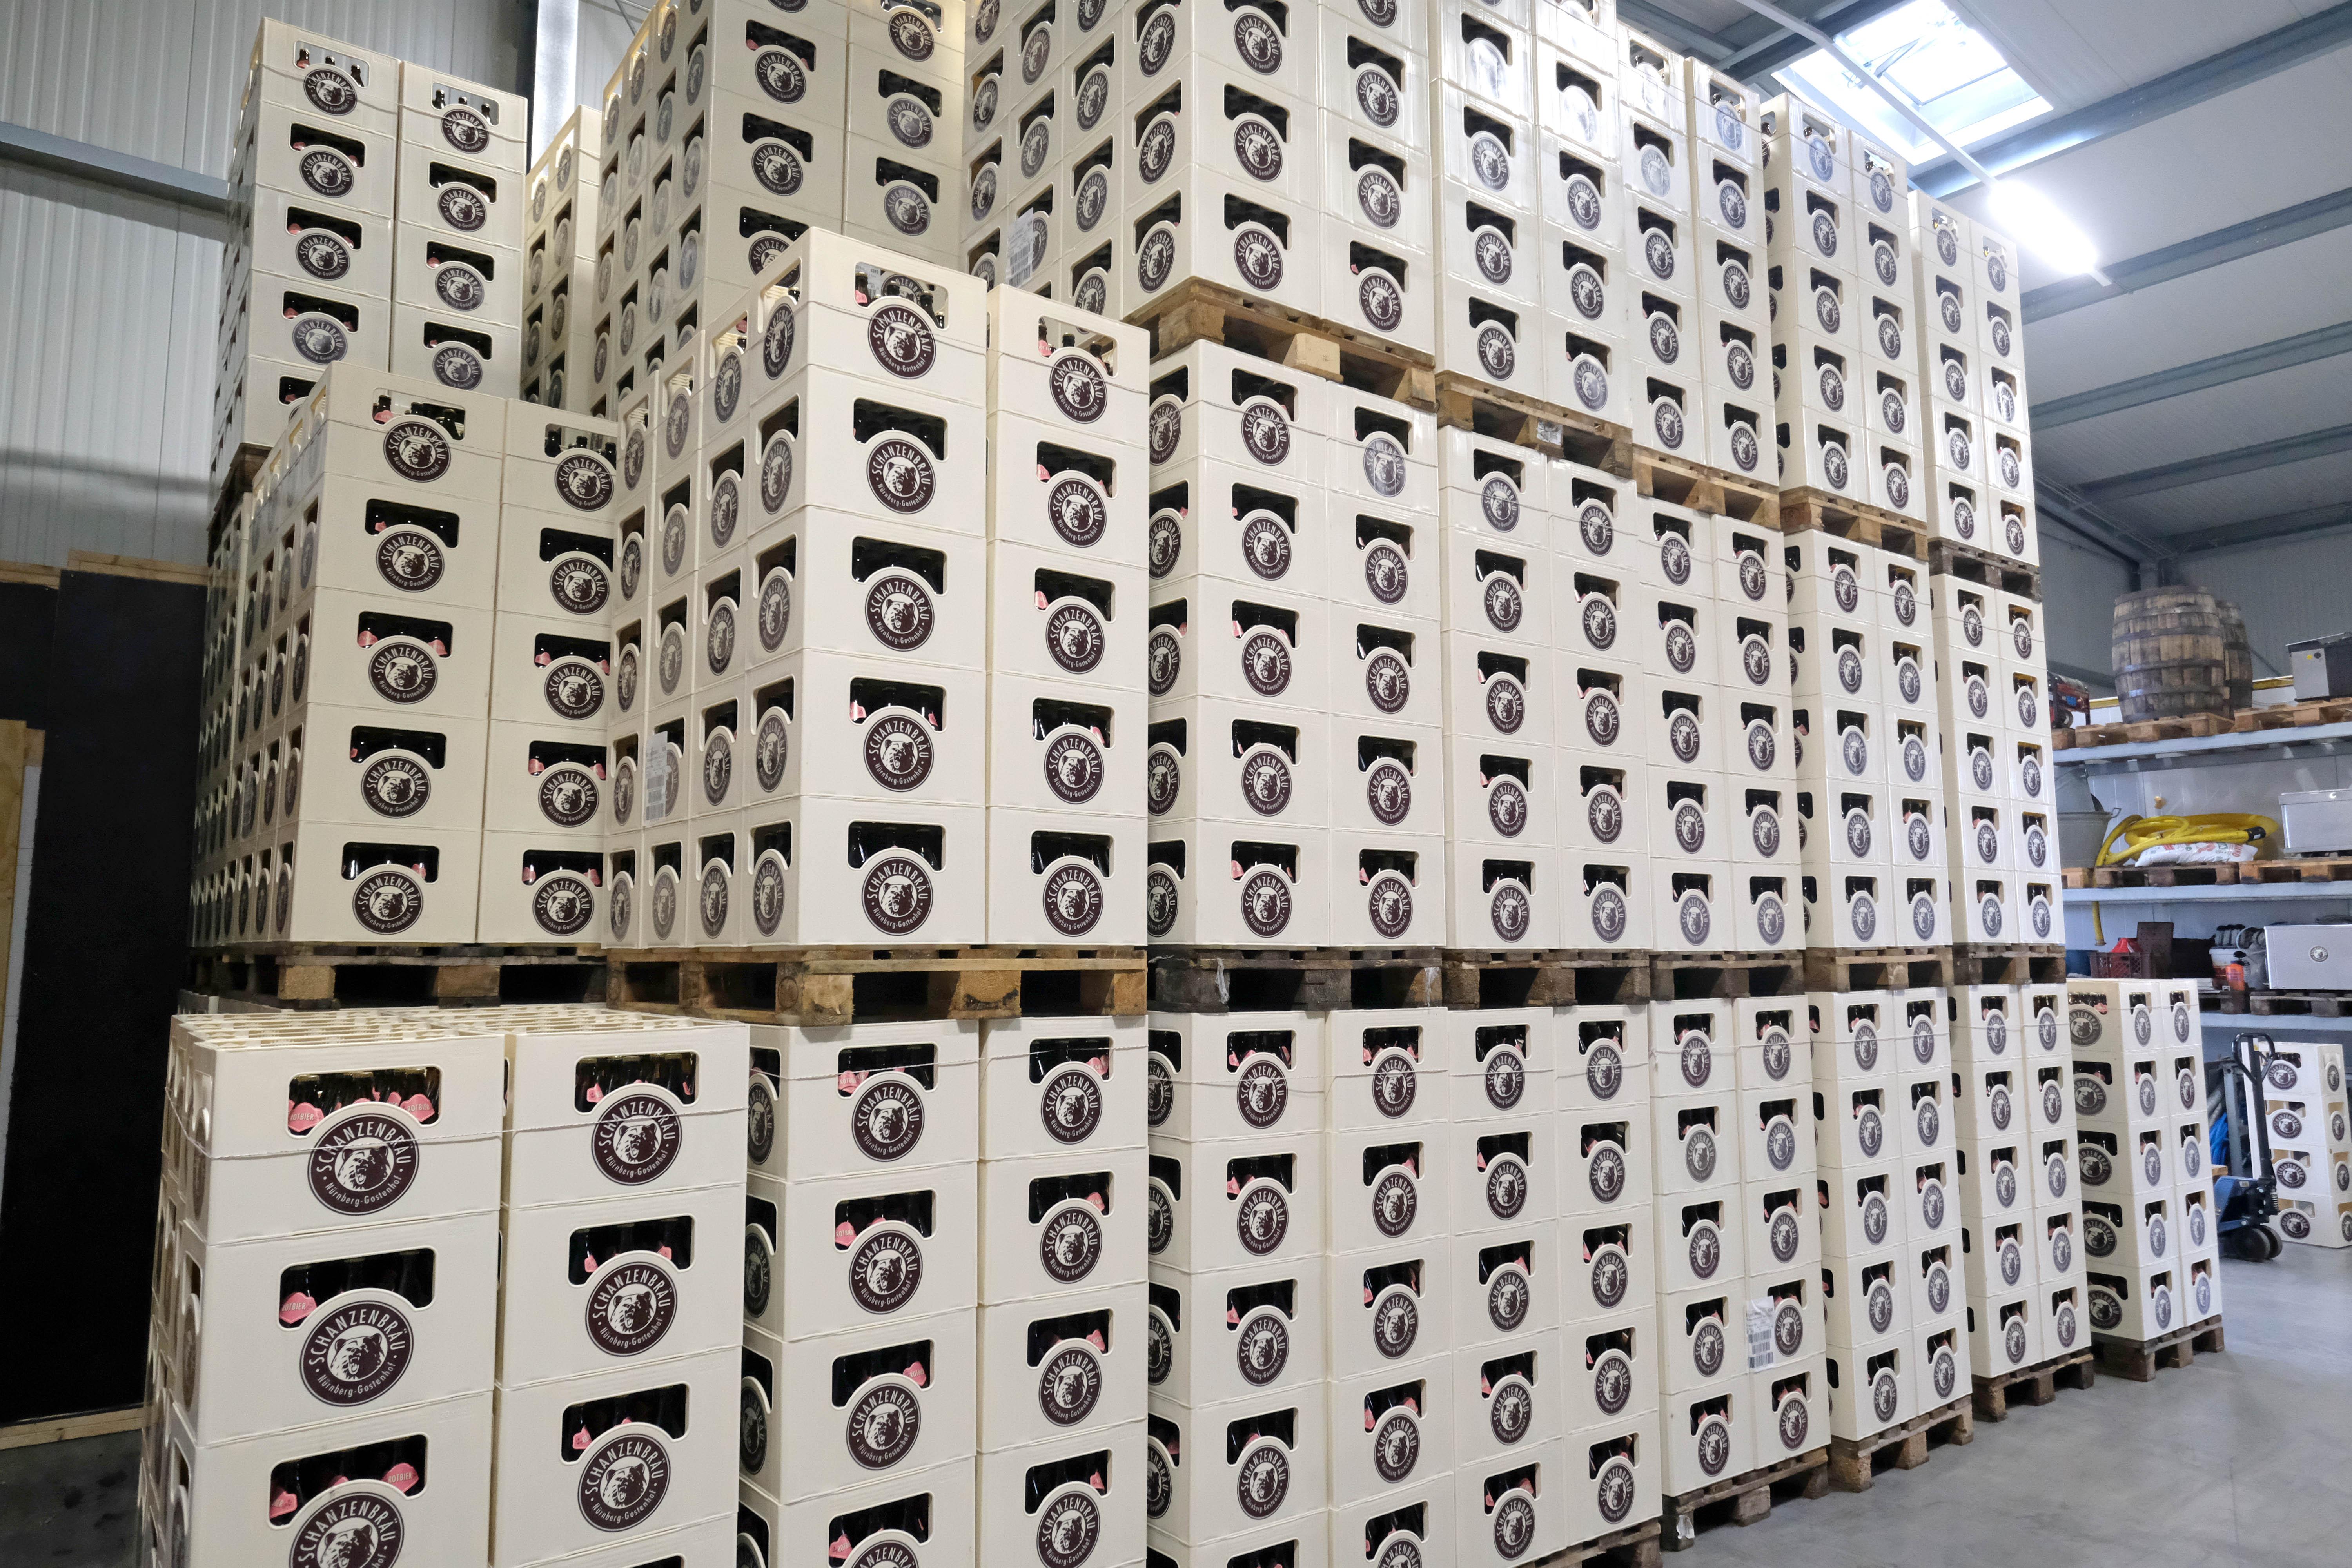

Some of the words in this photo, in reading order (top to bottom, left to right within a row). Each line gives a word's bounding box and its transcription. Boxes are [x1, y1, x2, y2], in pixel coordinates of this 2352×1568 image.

[1237, 18, 1279, 54] SCHANZENBRÄU
[759, 55, 803, 86] SCHANZENBRÄU
[1359, 74, 1396, 108] SCHANZENBRÄU
[1237, 125, 1279, 161] SCHANZENBRÄU
[304, 154, 350, 181] SCHANZENBRÄU
[755, 147, 800, 177] SCHANZENBRÄU
[441, 191, 484, 216] SCHANZENBRÄU
[299, 237, 347, 263] SCHANZENBRÄU
[753, 241, 785, 260] SCHANZEN
[1238, 234, 1280, 269] SCHANZENBRÄU
[1362, 278, 1399, 310] SCHANZENBRÄU
[873, 310, 932, 351] SCHANZENBRÄU
[1054, 361, 1103, 397] SCHANZENBRÄU
[388, 426, 447, 459] SCHANZENBRÄU
[872, 445, 931, 484] SCHANZENBRÄU
[878, 484, 925, 506] Nürnberg-Gostenhof
[1053, 484, 1103, 520] SCHANZENBRÄU
[1057, 519, 1097, 540] Nürnberg-Gostenhof
[1246, 522, 1288, 555] SCHANZENBRÄU
[381, 536, 441, 568] SCHANZENBRÄU
[1368, 550, 1405, 580] SCHANZENBRÄU
[554, 562, 606, 592] SCHANZENBRÄU
[870, 581, 930, 619] SCHANZENBRÄU
[1486, 582, 1519, 610] SCHANZENBRÄU
[876, 622, 923, 644] Nürnberg-Gostenhof
[1050, 610, 1101, 644] SCHANZENBRÄU
[374, 647, 434, 678] SCHANZENBRÄU
[1055, 647, 1095, 667] Nürnberg-Gostenhof
[1245, 637, 1288, 670] SCHANZENBRÄU
[549, 667, 601, 695] SCHANZENBRÄU
[1369, 659, 1406, 688] SCHANZENBRÄU
[1489, 683, 1522, 710] SCHANZENBRÄU
[869, 721, 929, 757] SCHANZENBRÄU
[1049, 739, 1100, 772] SCHANZENBRÄU
[366, 761, 427, 791] SCHANZENBRÄU
[543, 773, 596, 801] SCHANZENBRÄU
[875, 763, 923, 784] Nürnberg-Gostenhof
[1054, 777, 1094, 797] Nürnberg-Gostenhof
[1245, 756, 1289, 787] SCHANZENBRÄU
[1370, 769, 1408, 798] SCHANZENBRÄU
[1491, 786, 1524, 812] SCHANZENBRÄU
[358, 876, 419, 905] SCHANZENBRÄU
[537, 881, 591, 908] SCHANZENBRÄU
[867, 863, 929, 898] SCHANZENBRÄU
[1047, 870, 1100, 903] SCHANZENBRÄU
[1245, 877, 1289, 907] SCHANZENBRÄU
[1372, 882, 1410, 909] SCHANZENBRÄU
[873, 907, 922, 928] Nürnberg-Gostenhof
[1494, 889, 1527, 915] SCHANZENBRÄU
[1053, 910, 1094, 930] Nürnberg-Gostenhof
[1241, 1066, 1284, 1098] SCHANZENBRÄU
[1376, 1060, 1413, 1090] SCHANZENBRÄU
[407, 1104, 429, 1112] ROTBIER
[857, 1087, 920, 1126] SCHANZENBRÄU
[1045, 1076, 1099, 1111] SCHANZENBRÄU
[599, 1101, 677, 1146] SCHANZENBRÄU
[1051, 1116, 1093, 1138] Nürnberg-Gostenhof
[316, 1122, 413, 1172] SCHANZENBRÄU
[863, 1130, 913, 1155] Nürnberg-Gostenhof
[1489, 1165, 1524, 1194] SCHANZENBRÄU
[1592, 1151, 1622, 1179] SCHANZENBRÄU
[1241, 1191, 1285, 1226] SCHANZENBRÄU
[1376, 1177, 1414, 1210] SCHANZENBRÄU
[1045, 1213, 1098, 1251] SCHANZENBRÄU
[855, 1237, 918, 1279] SCHANZENBRÄU
[1050, 1253, 1092, 1277] Nürnberg-Gostenhof
[1594, 1255, 1625, 1284] SCHANZENBRÄU
[592, 1269, 672, 1318] SCHANZENBRÄU
[861, 1279, 911, 1307] Nürnberg-Gostenhof
[1491, 1275, 1526, 1307] SCHANZENBRÄU
[1377, 1297, 1415, 1332] SCHANZENBRÄU
[309, 1309, 407, 1365] SCHANZENBRÄU
[600, 1317, 662, 1348] Nürnberg-Gostenhof
[1241, 1319, 1285, 1356] SCHANZENBRÄU
[318, 1361, 396, 1397] Nürnberg-Gostenhof
[1044, 1354, 1098, 1394] SCHANZENBRÄU
[1597, 1361, 1628, 1391] SCHANZENBRÄU
[852, 1390, 916, 1436] SCHANZENBRÄU
[1049, 1394, 1091, 1420] Nürnberg-Gostenhof
[1494, 1387, 1529, 1420] SCHANZENBRÄU
[858, 1433, 909, 1463] Nürnberg-Gostenhof
[1377, 1419, 1417, 1456] SCHANZENBRÄU
[388, 1472, 412, 1483] ROTBIER
[585, 1441, 665, 1495] SCHANZENBRÄU
[1241, 1451, 1286, 1490] SCHANZENBRÄU
[1601, 1468, 1632, 1500] SCHANZENBRÄU
[592, 1489, 655, 1523] Nürnberg-Gostenhof
[1041, 1497, 1096, 1541] SCHANZENBRÄU
[1497, 1501, 1532, 1536] SCHANZENBRÄU
[298, 1501, 396, 1562] SCHANZENBRÄU
[1047, 1537, 1090, 1566] Nürnberg-Gostenhof
